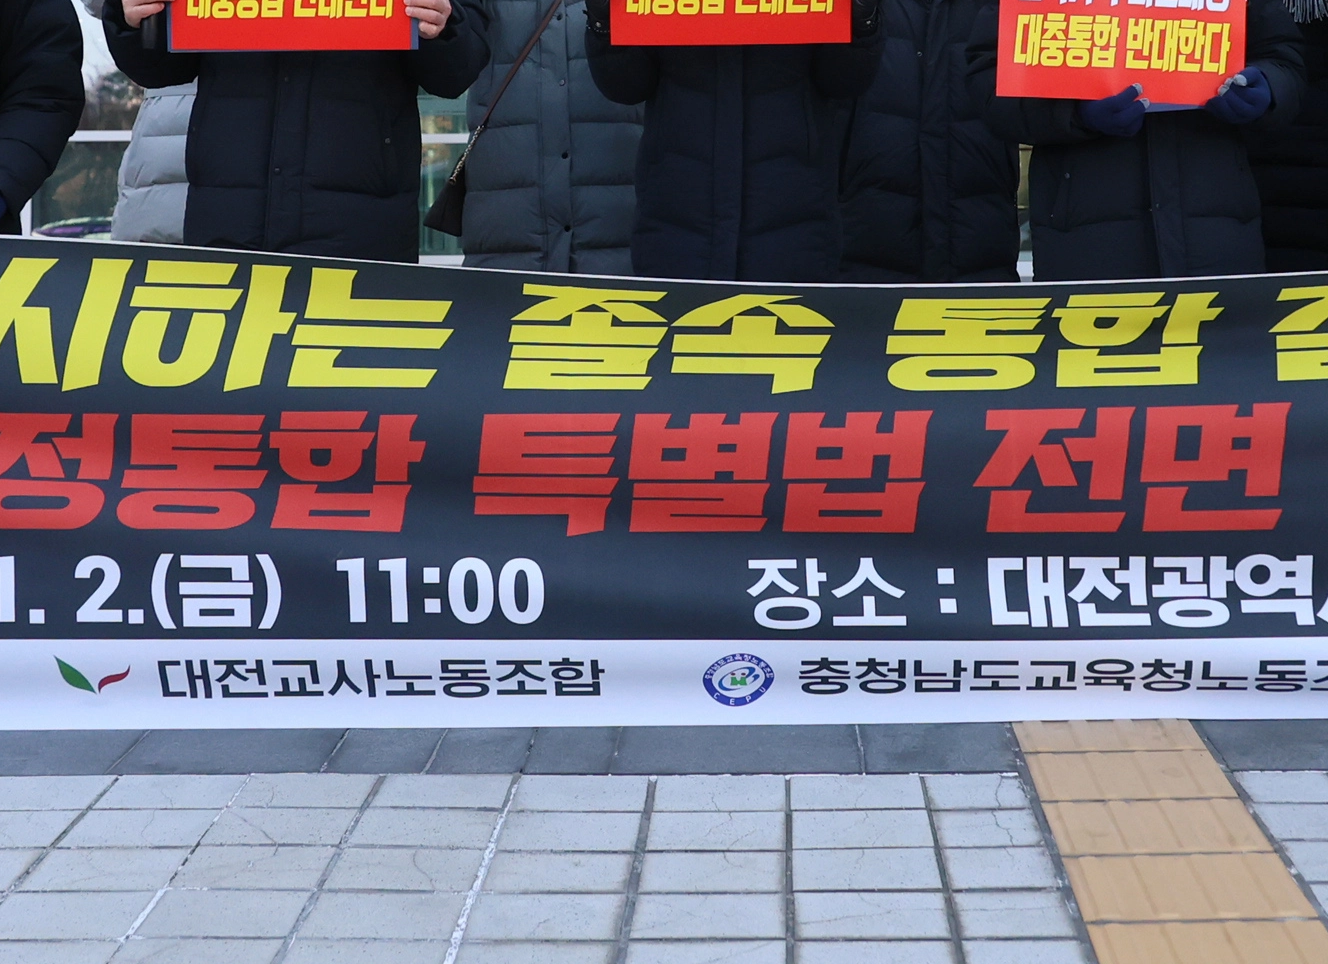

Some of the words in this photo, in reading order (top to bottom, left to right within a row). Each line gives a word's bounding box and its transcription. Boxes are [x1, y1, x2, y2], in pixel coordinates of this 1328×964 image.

[1014, 13, 1120, 67] 대충통합
[1126, 18, 1230, 75] 반대한다
[504, 284, 834, 393] 졸속
[887, 293, 1223, 390] 통합
[474, 411, 933, 536] 특별법
[974, 403, 1291, 532] 전면
[75, 554, 281, 629] 2.(금)
[337, 558, 544, 624] 11:00
[747, 558, 906, 629] 장소
[158, 658, 605, 698] 대전교사노동조합
